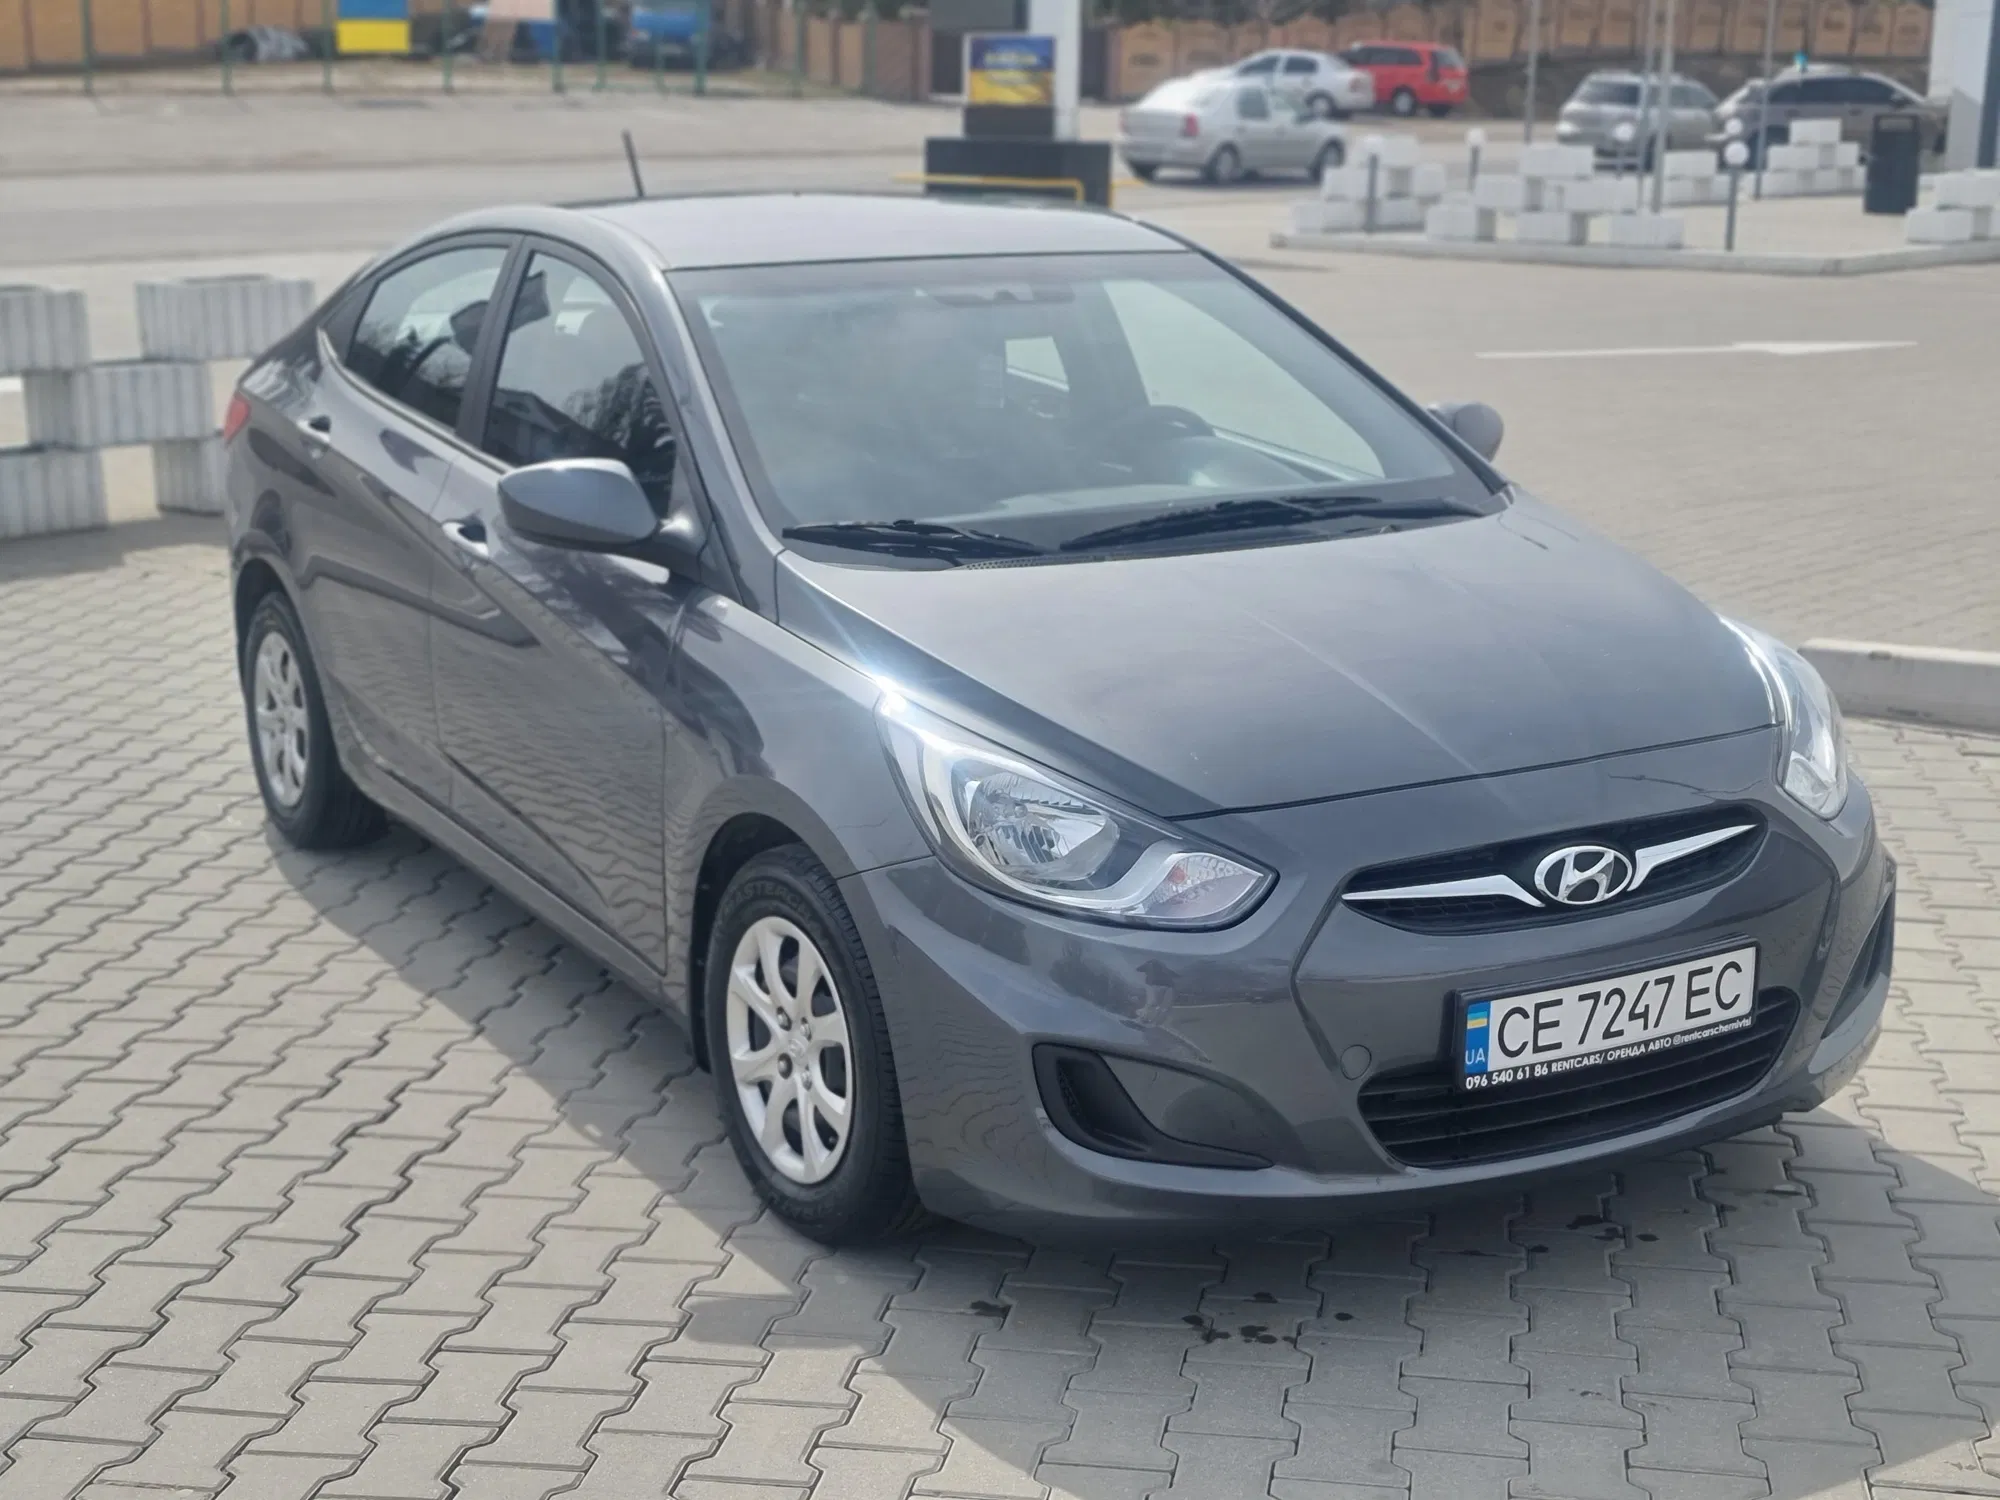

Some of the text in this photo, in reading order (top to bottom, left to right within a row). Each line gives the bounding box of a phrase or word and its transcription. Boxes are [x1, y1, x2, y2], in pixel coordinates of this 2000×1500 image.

[1497, 961, 1743, 1058] CE 7247 EC
[1465, 1048, 1486, 1065] UA
[1465, 1074, 1488, 1090] 096
[1491, 1069, 1514, 1085] 540
[1516, 1065, 1530, 1080] 61
[1534, 1062, 1549, 1077] 86
[1606, 1043, 1646, 1061] ОРЕНДА
[1648, 1037, 1672, 1052] АВТО
